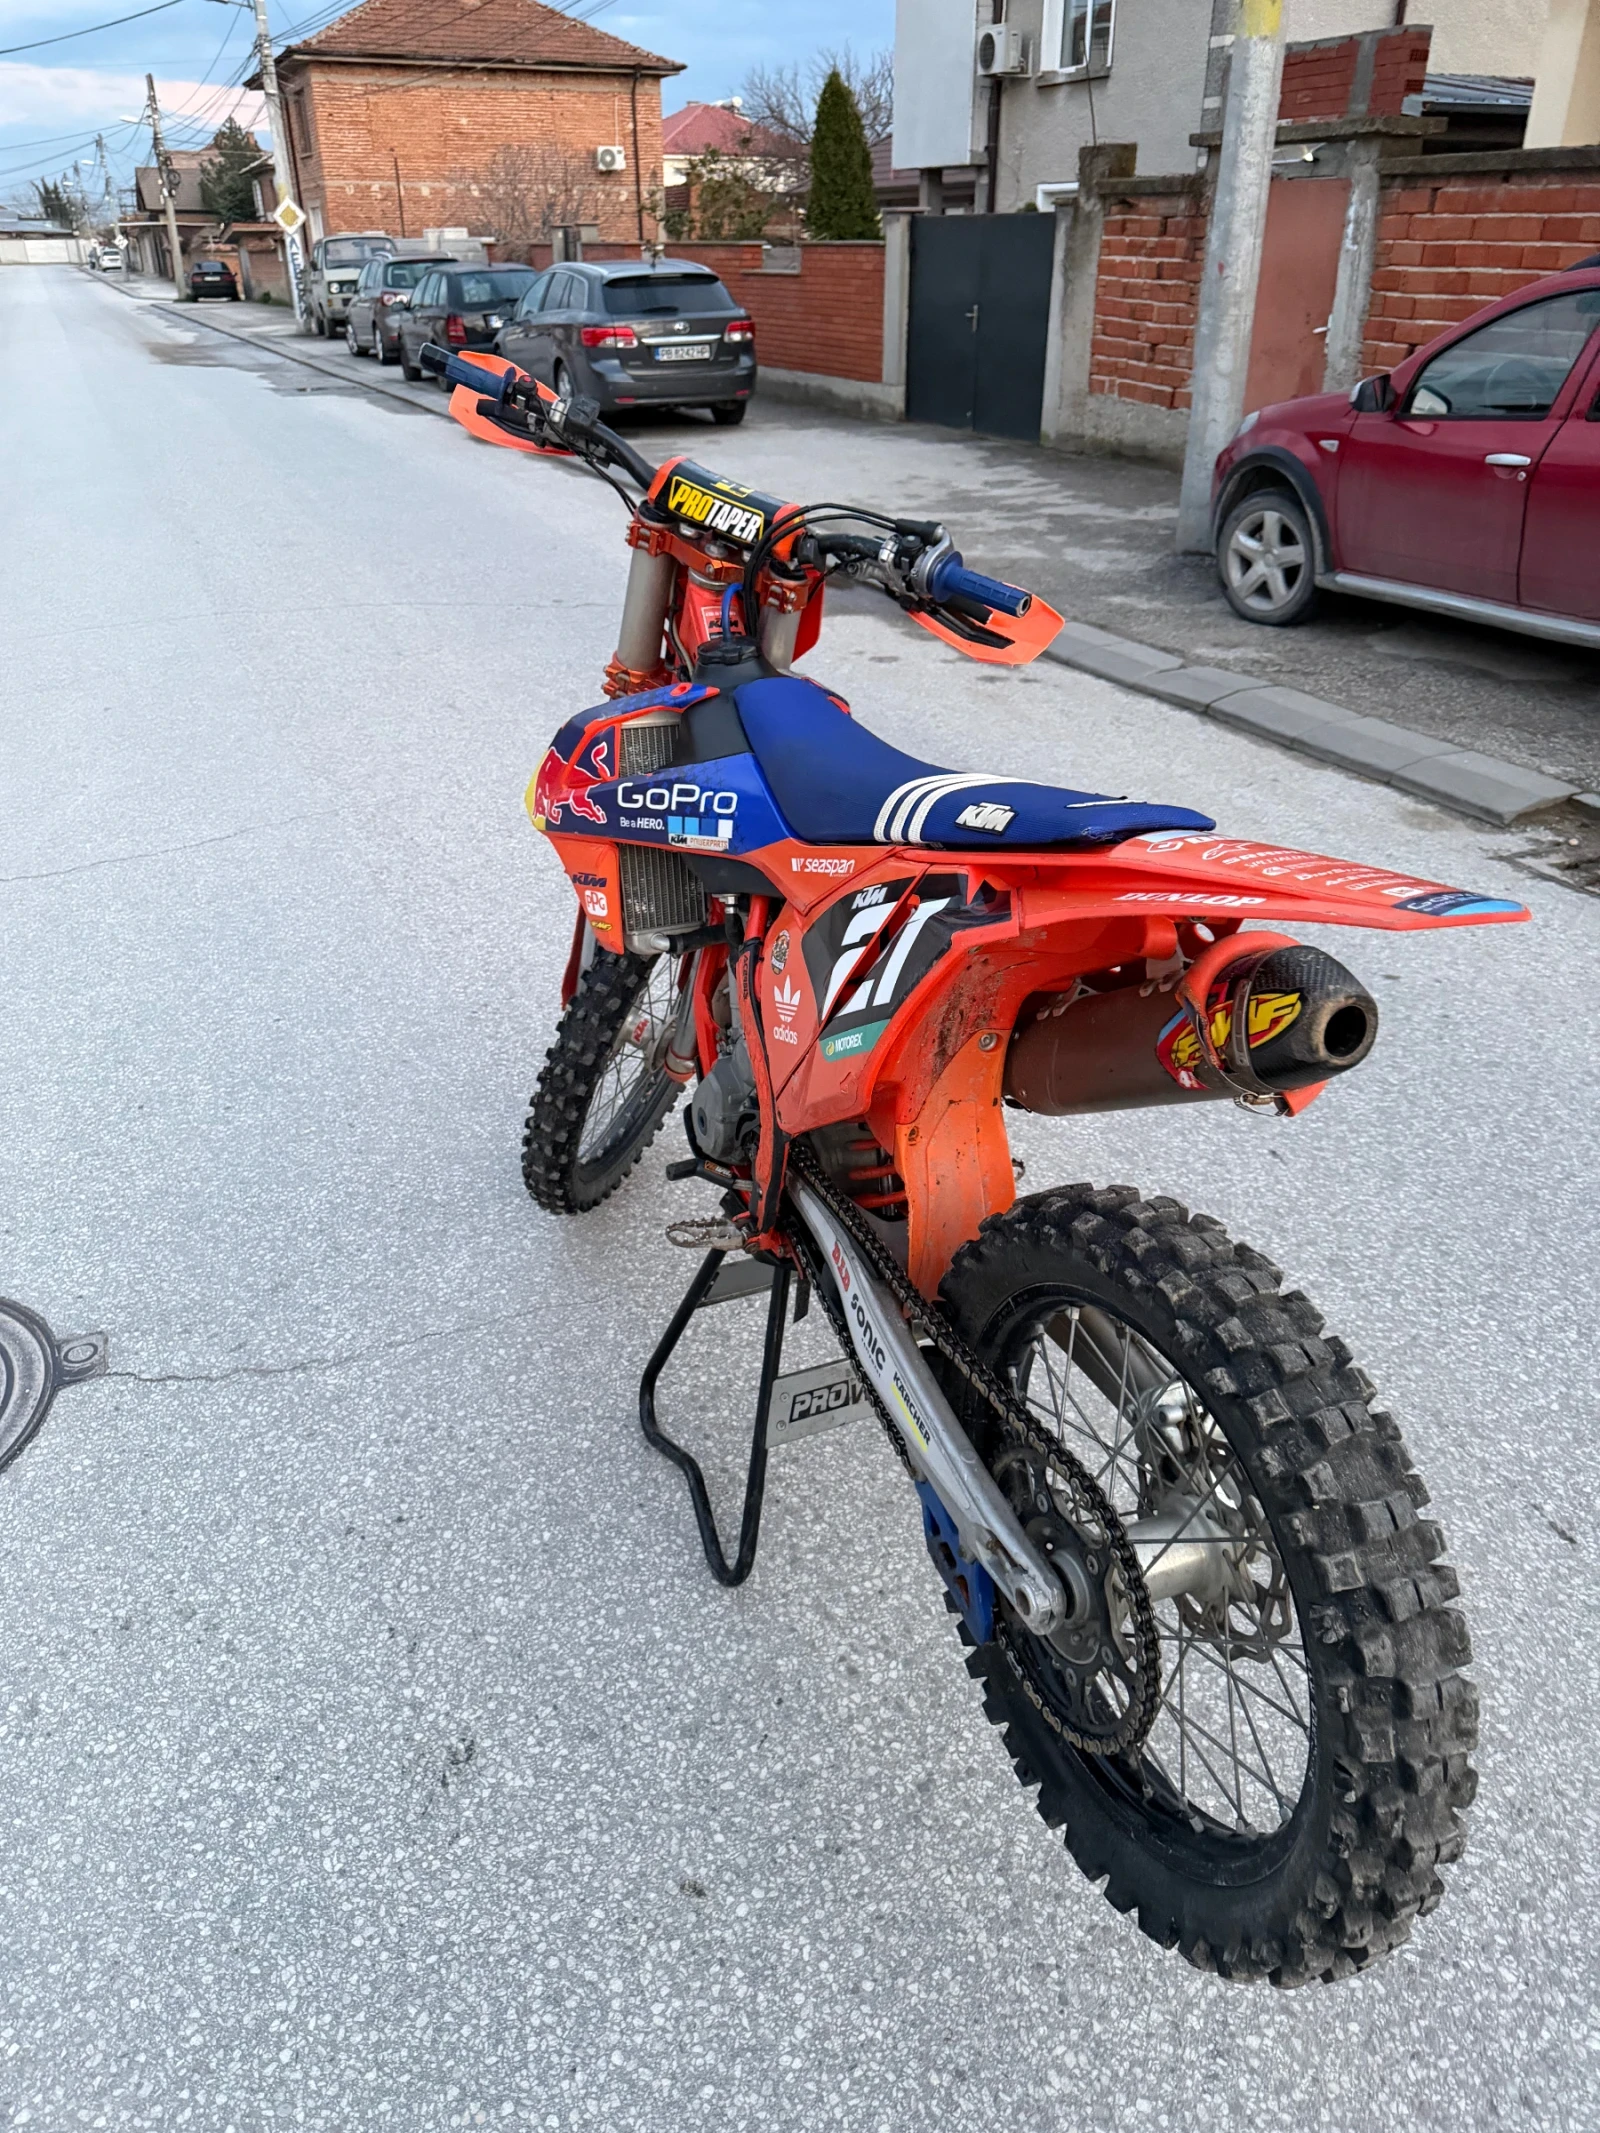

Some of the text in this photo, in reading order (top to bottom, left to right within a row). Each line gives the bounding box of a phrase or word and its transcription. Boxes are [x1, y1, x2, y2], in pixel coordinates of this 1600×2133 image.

[671, 483, 762, 543] PROTAPER
[708, 617, 738, 629] KM
[617, 782, 738, 814] GoPro
[620, 816, 630, 828] Be
[636, 817, 665, 830] HERO.
[955, 802, 1015, 832] KTM
[670, 834, 688, 845] KTM
[803, 858, 856, 878] seaspan
[572, 872, 607, 887] KTM
[586, 891, 606, 911] PPG
[851, 884, 888, 910] KTM
[1112, 892, 1267, 907] DUNLOP
[773, 1024, 798, 1045] adidas
[835, 1032, 863, 1052] MOTOREX
[893, 1372, 931, 1445] KÄRCHER
